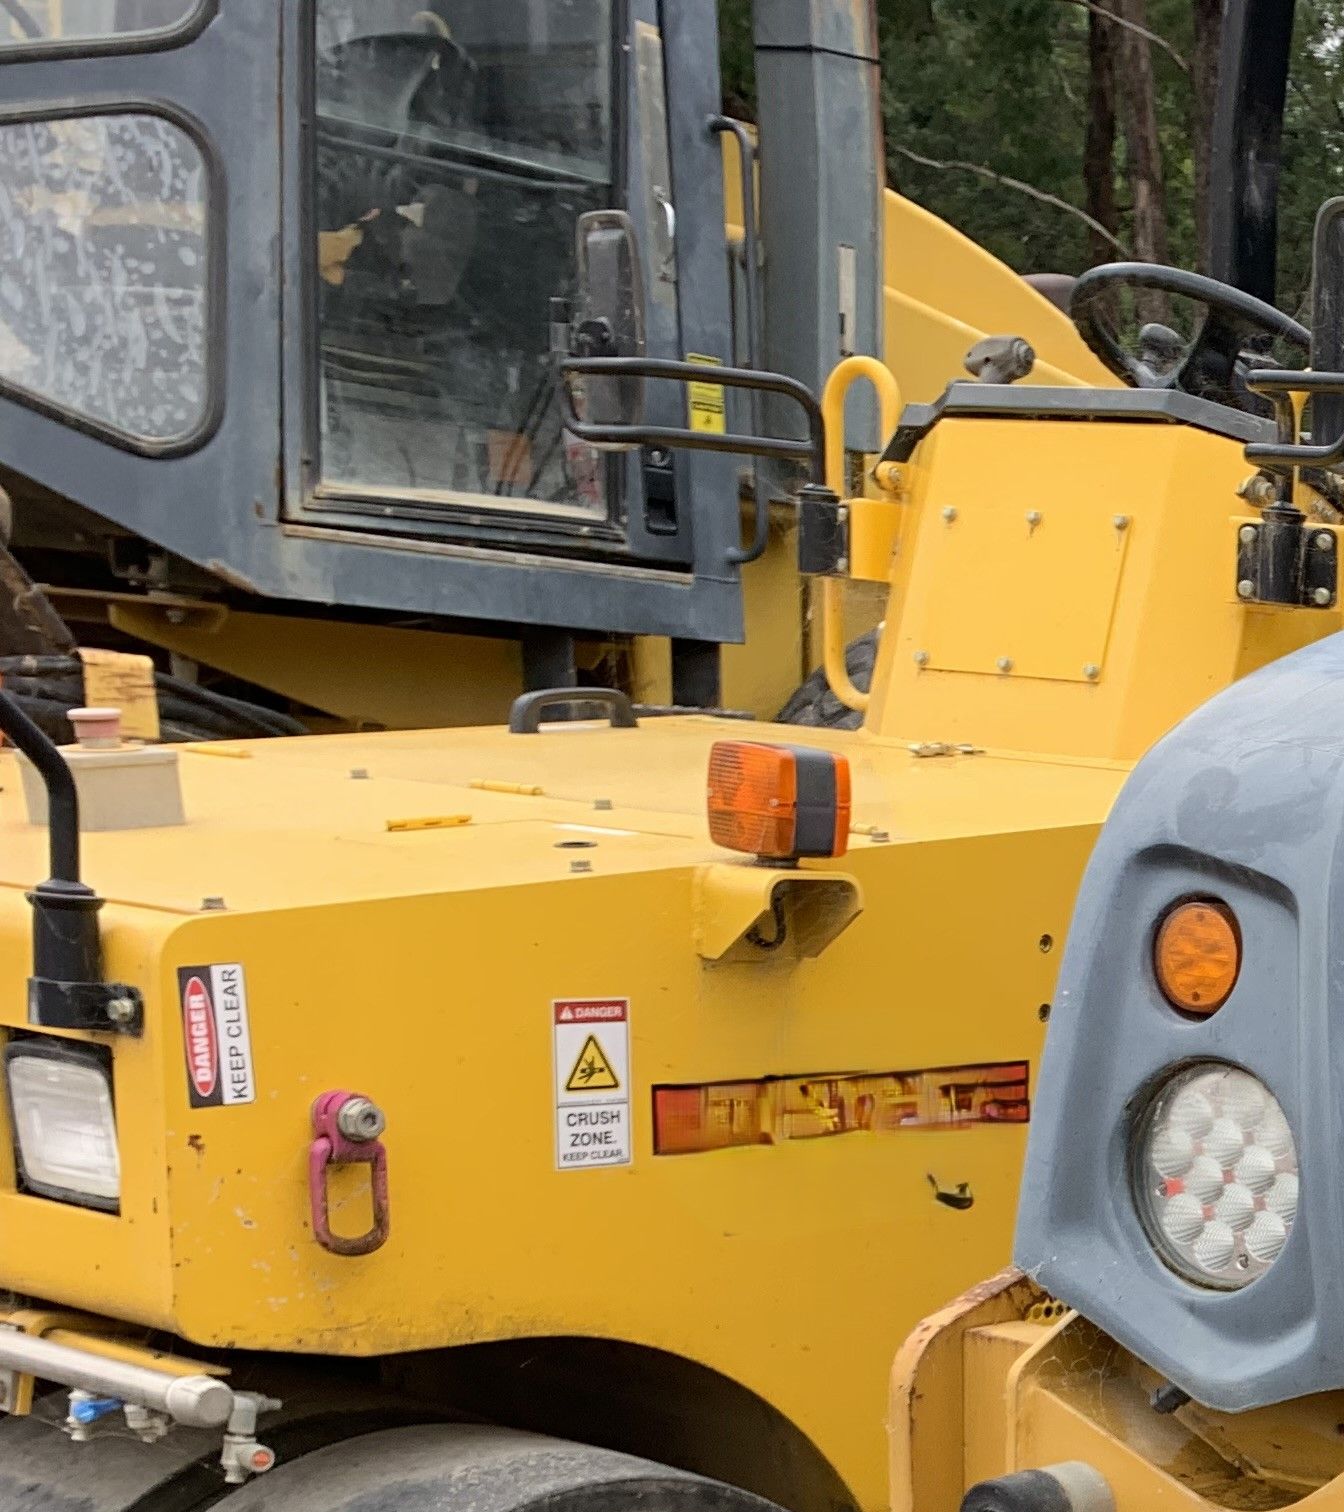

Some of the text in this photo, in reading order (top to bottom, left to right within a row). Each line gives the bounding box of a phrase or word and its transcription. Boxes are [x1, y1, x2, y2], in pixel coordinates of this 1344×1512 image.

[574, 1006, 623, 1019] DANGER
[188, 993, 213, 1083] DANGER
[221, 968, 248, 1100] KEEP CLEAR
[566, 1110, 621, 1127] CRUSH
[562, 1151, 589, 1162] KEEP
